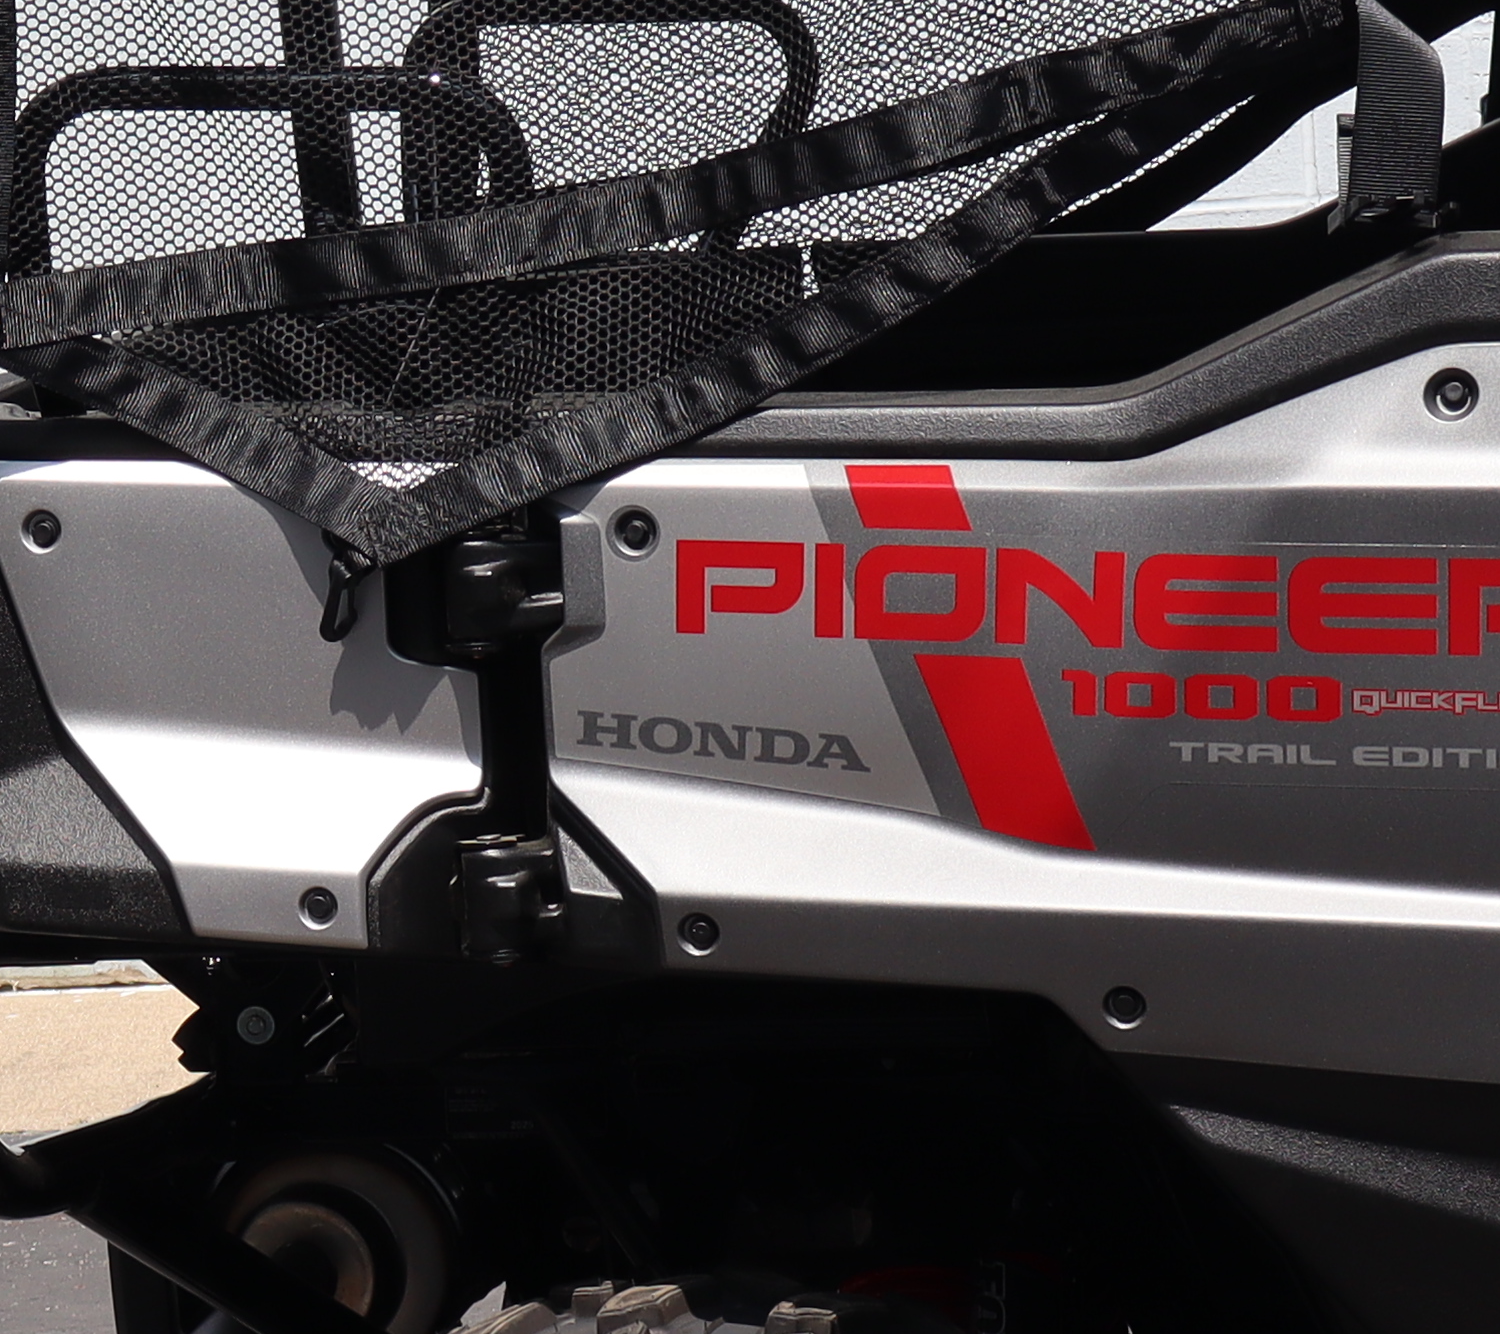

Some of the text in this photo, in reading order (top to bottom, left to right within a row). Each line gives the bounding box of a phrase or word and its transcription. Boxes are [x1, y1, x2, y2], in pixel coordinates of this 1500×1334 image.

[1061, 668, 1343, 722] 1000
[576, 710, 871, 772] HONDA
[1169, 741, 1337, 765] TRAIL
